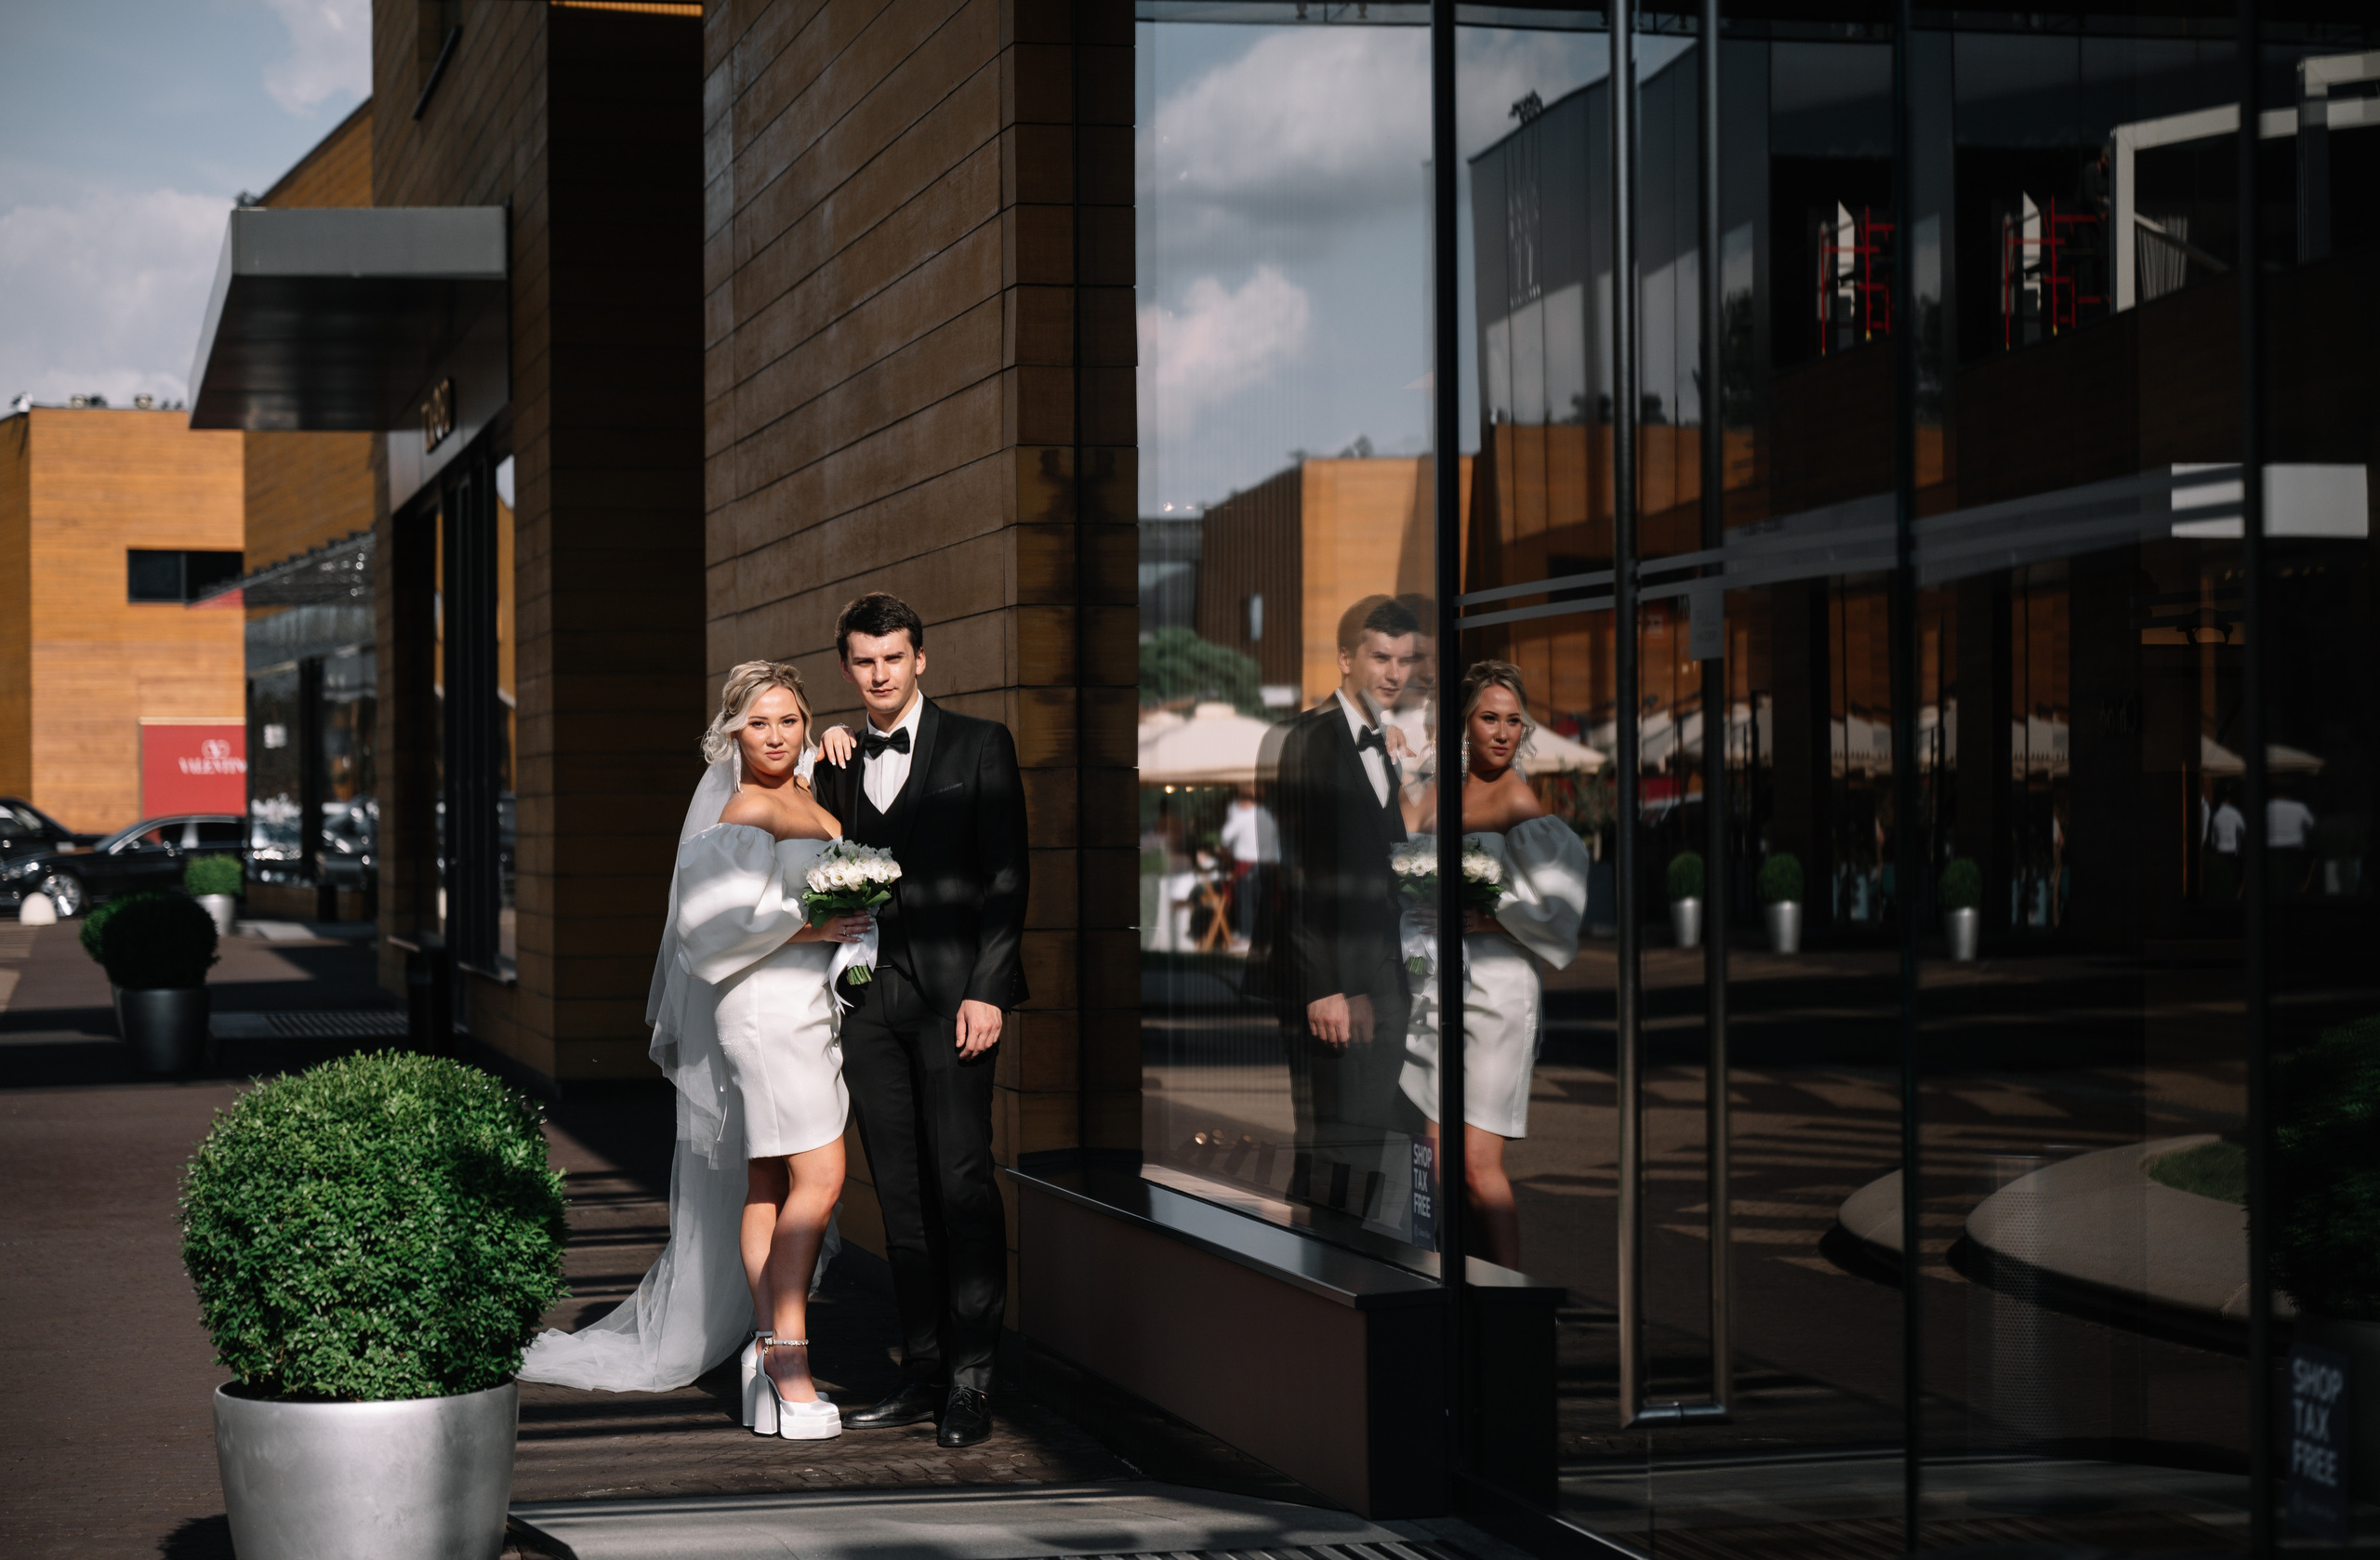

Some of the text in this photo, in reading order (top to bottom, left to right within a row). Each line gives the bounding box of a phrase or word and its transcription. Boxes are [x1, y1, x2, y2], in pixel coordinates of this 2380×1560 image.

[1414, 1144, 1432, 1168] SHOP
[1414, 1169, 1428, 1192] TAX
[1414, 1193, 1431, 1218] FREE
[2292, 1357, 2344, 1404] SHOP
[2292, 1397, 2331, 1443] TAX
[2292, 1439, 2338, 1487] FREE
